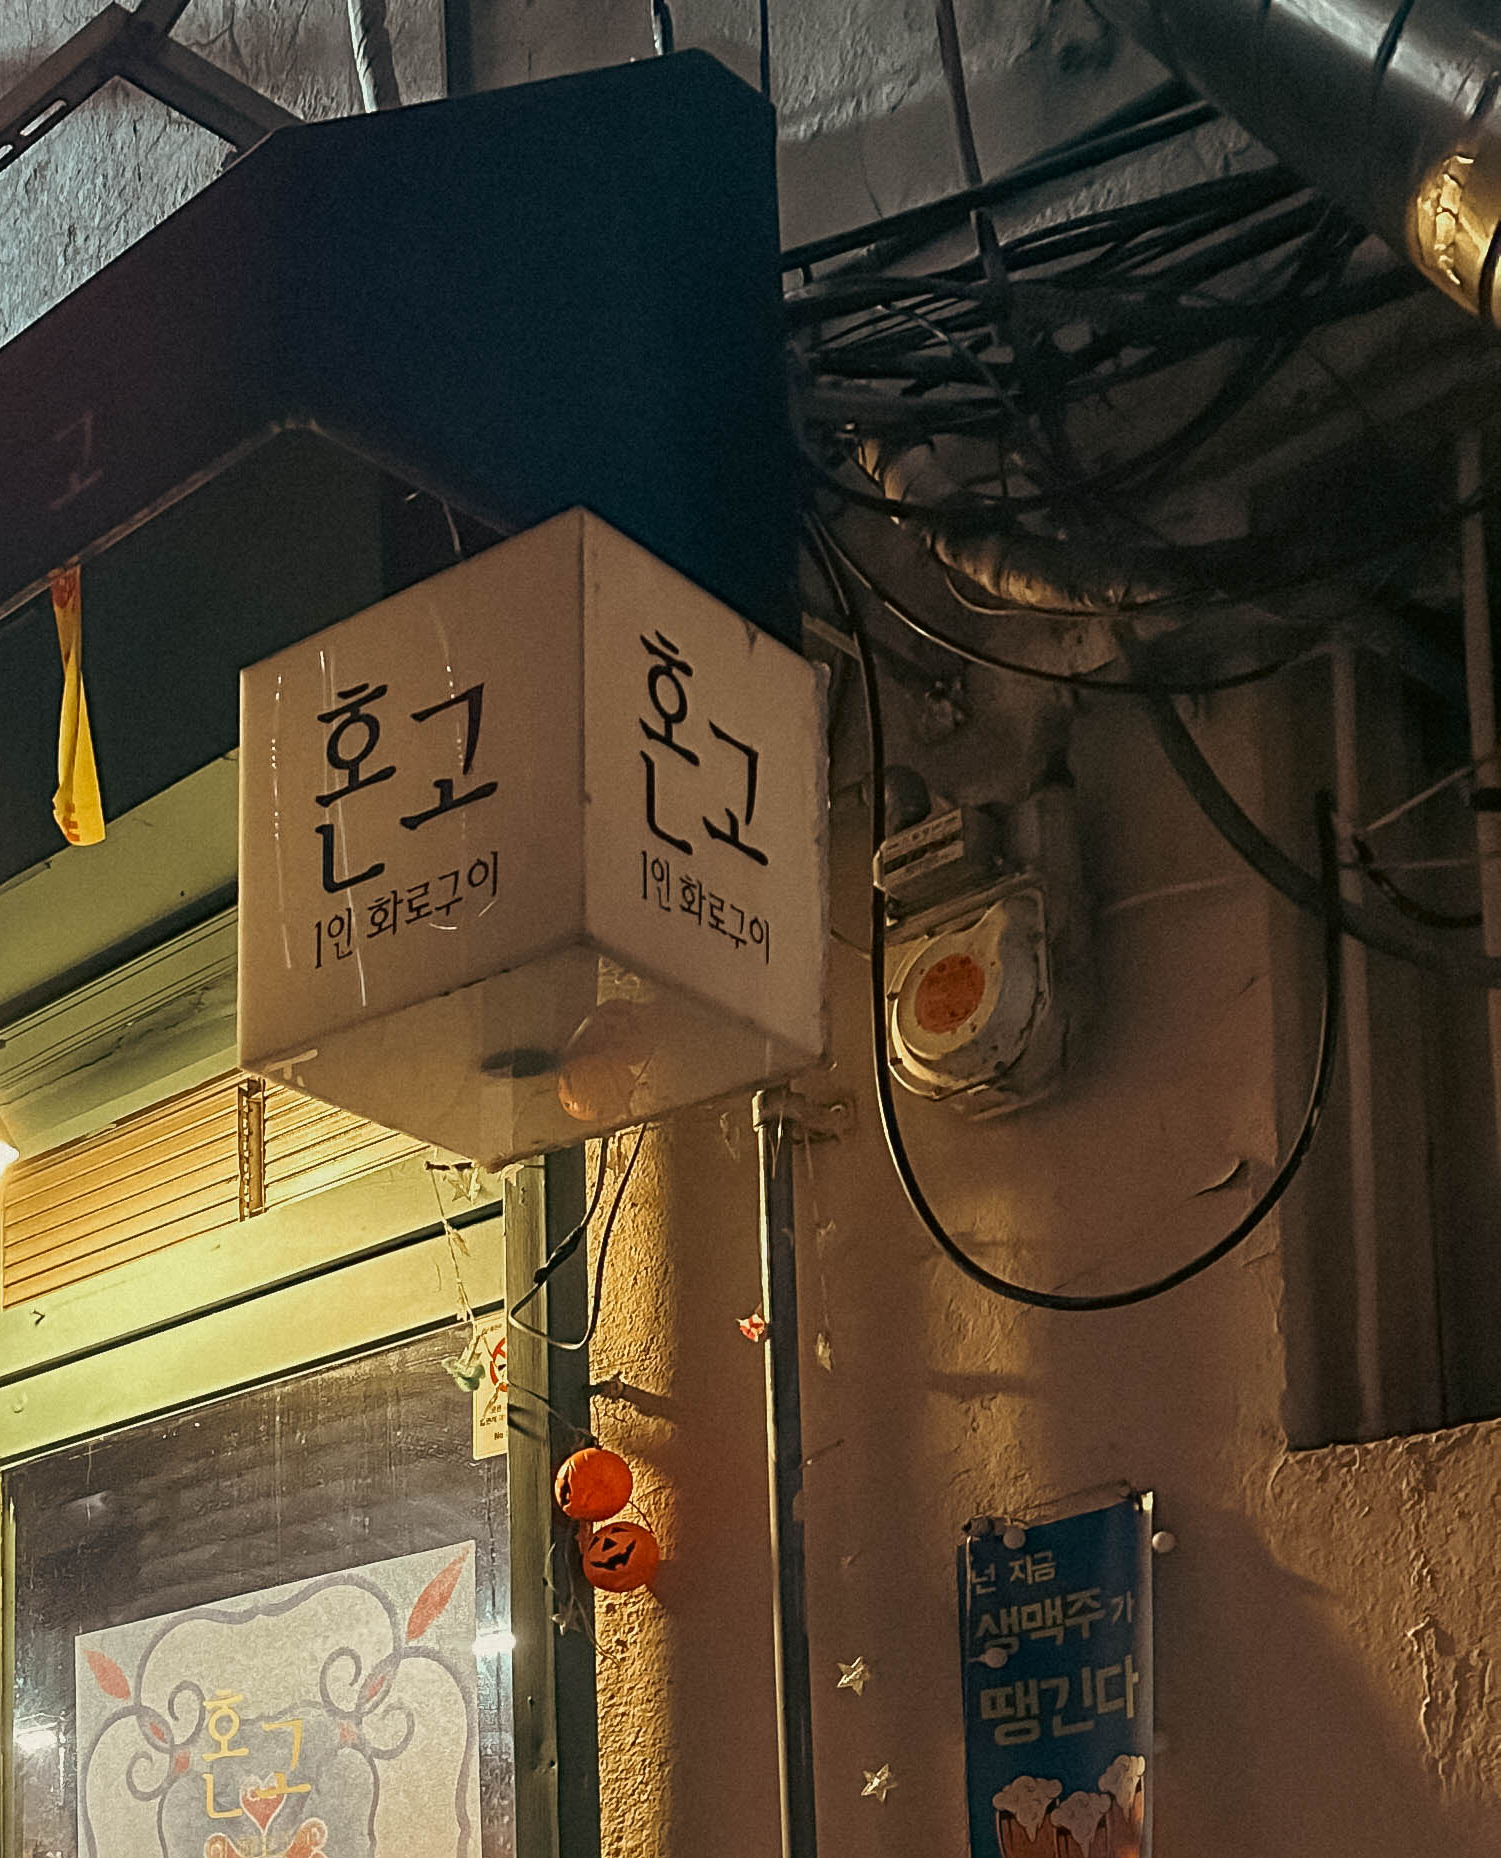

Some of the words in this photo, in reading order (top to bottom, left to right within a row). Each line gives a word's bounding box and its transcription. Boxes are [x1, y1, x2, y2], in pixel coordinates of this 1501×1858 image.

[315, 683, 498, 893] 혼고
[638, 630, 768, 866] 혼고
[315, 907, 353, 968] 1인
[367, 851, 498, 939] 화로구이
[642, 850, 671, 912] 1인
[679, 874, 770, 965] 화로구이
[1009, 1551, 1056, 1584] 지금
[203, 1689, 311, 1818] 혼고
[980, 1654, 1139, 1745] 땡긴다
